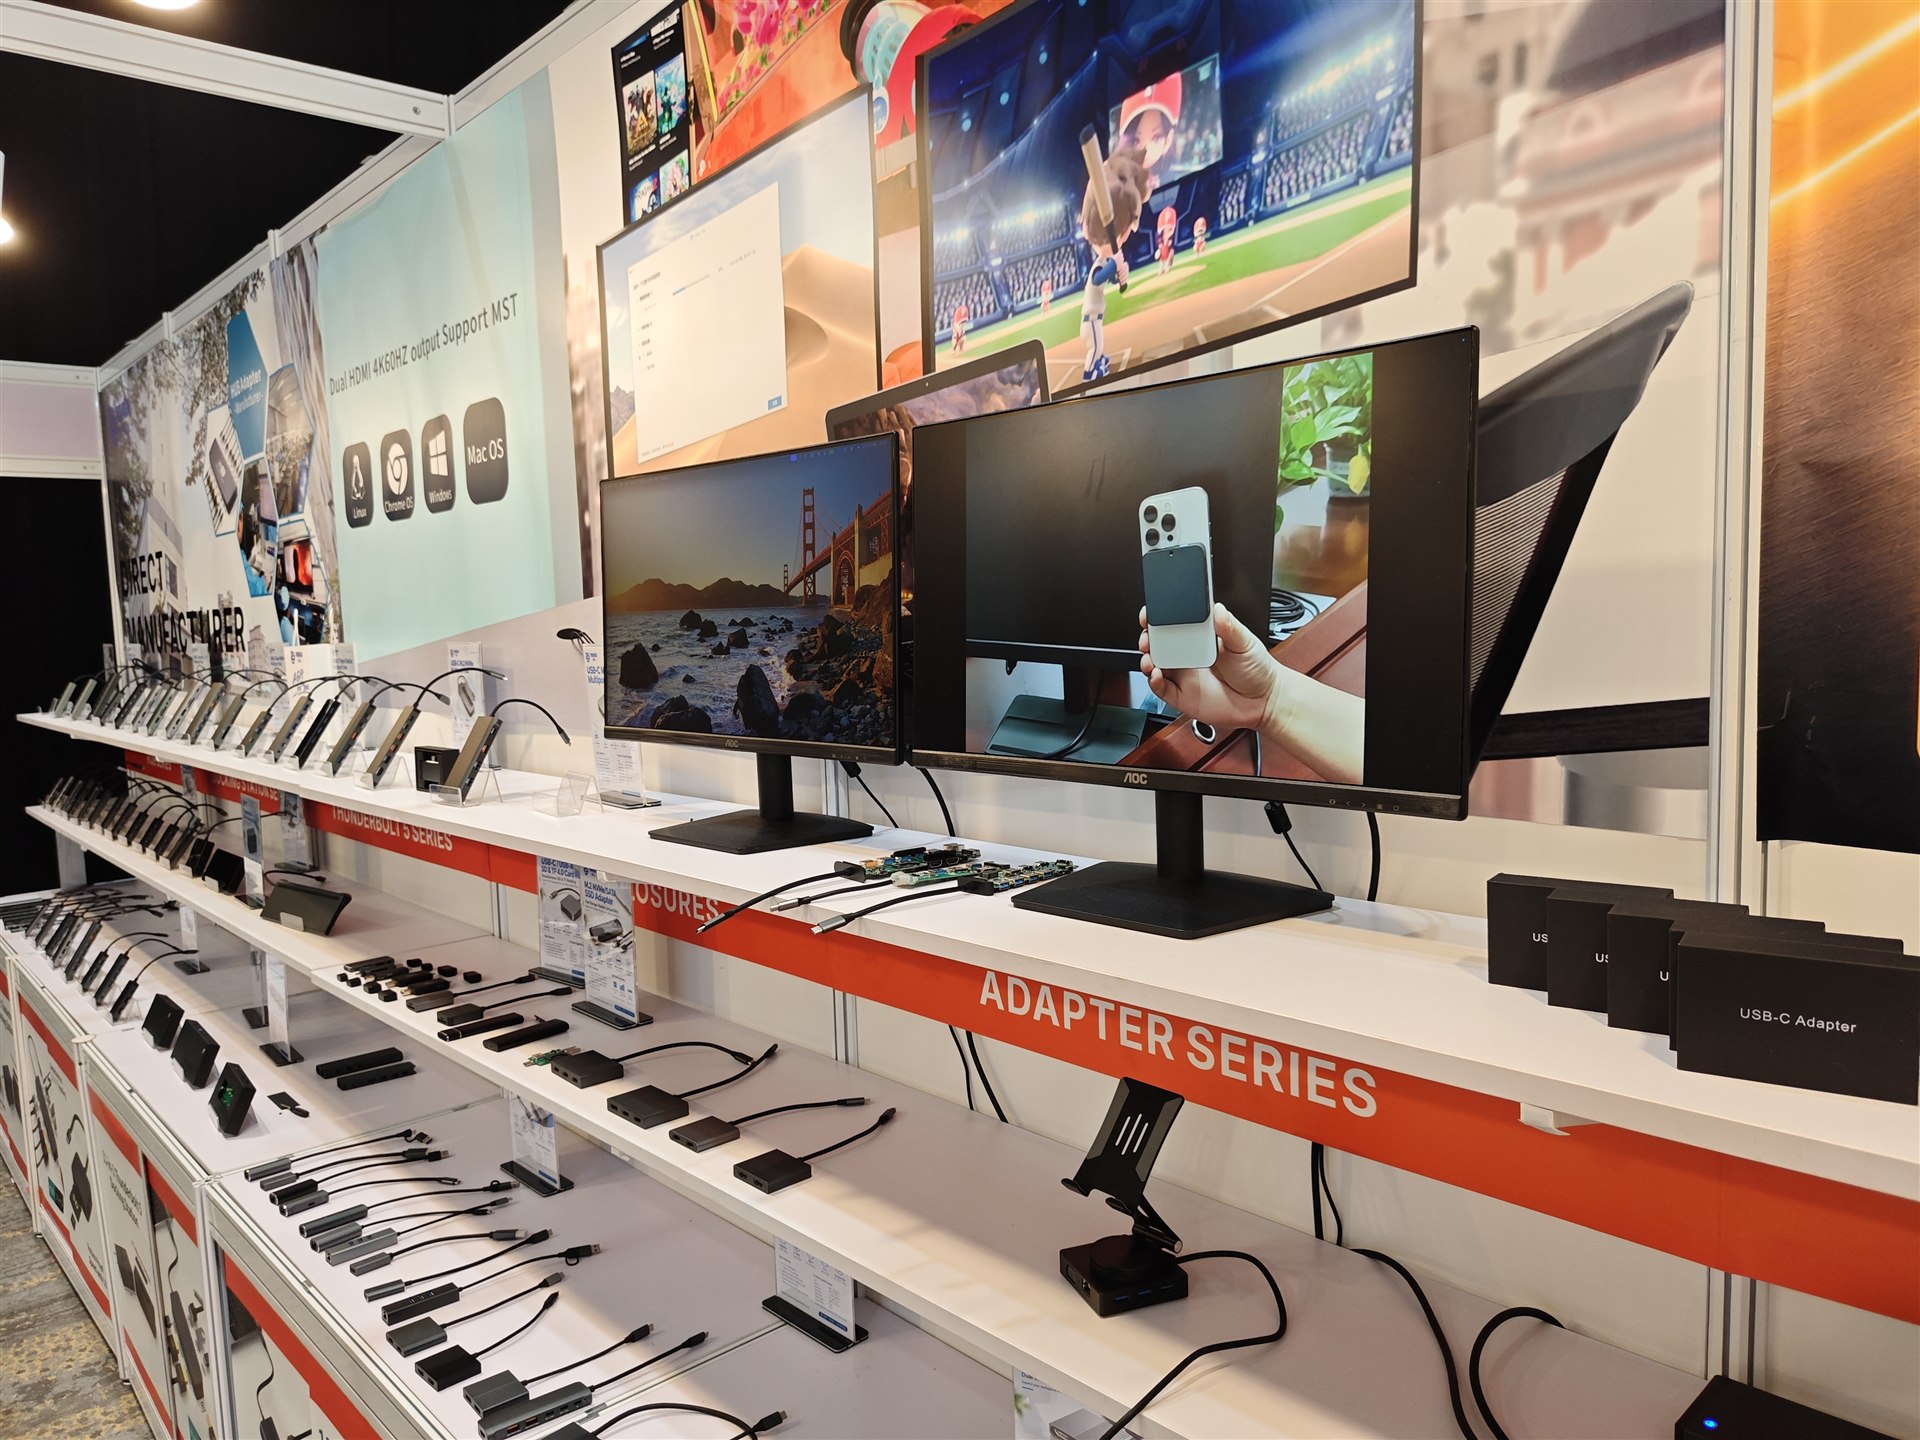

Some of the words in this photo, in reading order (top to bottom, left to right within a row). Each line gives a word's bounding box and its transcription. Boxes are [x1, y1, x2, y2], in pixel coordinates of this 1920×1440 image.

[330, 370, 348, 396] Dual
[349, 362, 372, 387] HDMI
[373, 345, 409, 377] 4K60HZ
[411, 329, 441, 361] output
[442, 307, 489, 346] Support
[491, 293, 518, 325] MST
[467, 445, 488, 466] Mac
[488, 438, 504, 461] OS
[384, 500, 407, 514] Chrome
[407, 496, 414, 509] OS
[428, 489, 453, 504] Windows
[353, 507, 367, 520] Linux
[120, 551, 163, 597] DIRECT
[126, 607, 246, 653] MANUFACTURER
[1123, 771, 1148, 785] AOC
[331, 805, 401, 837] THUNDERBOLT
[403, 822, 410, 840] 5
[411, 825, 454, 851] SERIES
[584, 889, 595, 899] SSD
[632, 883, 720, 921] OSURES
[1532, 932, 1549, 943] US
[1740, 1007, 1791, 1025] USB-C
[1795, 1015, 1857, 1033] Adapter
[979, 970, 1175, 1061] ADAPTER
[1186, 1026, 1378, 1118] SERIES
